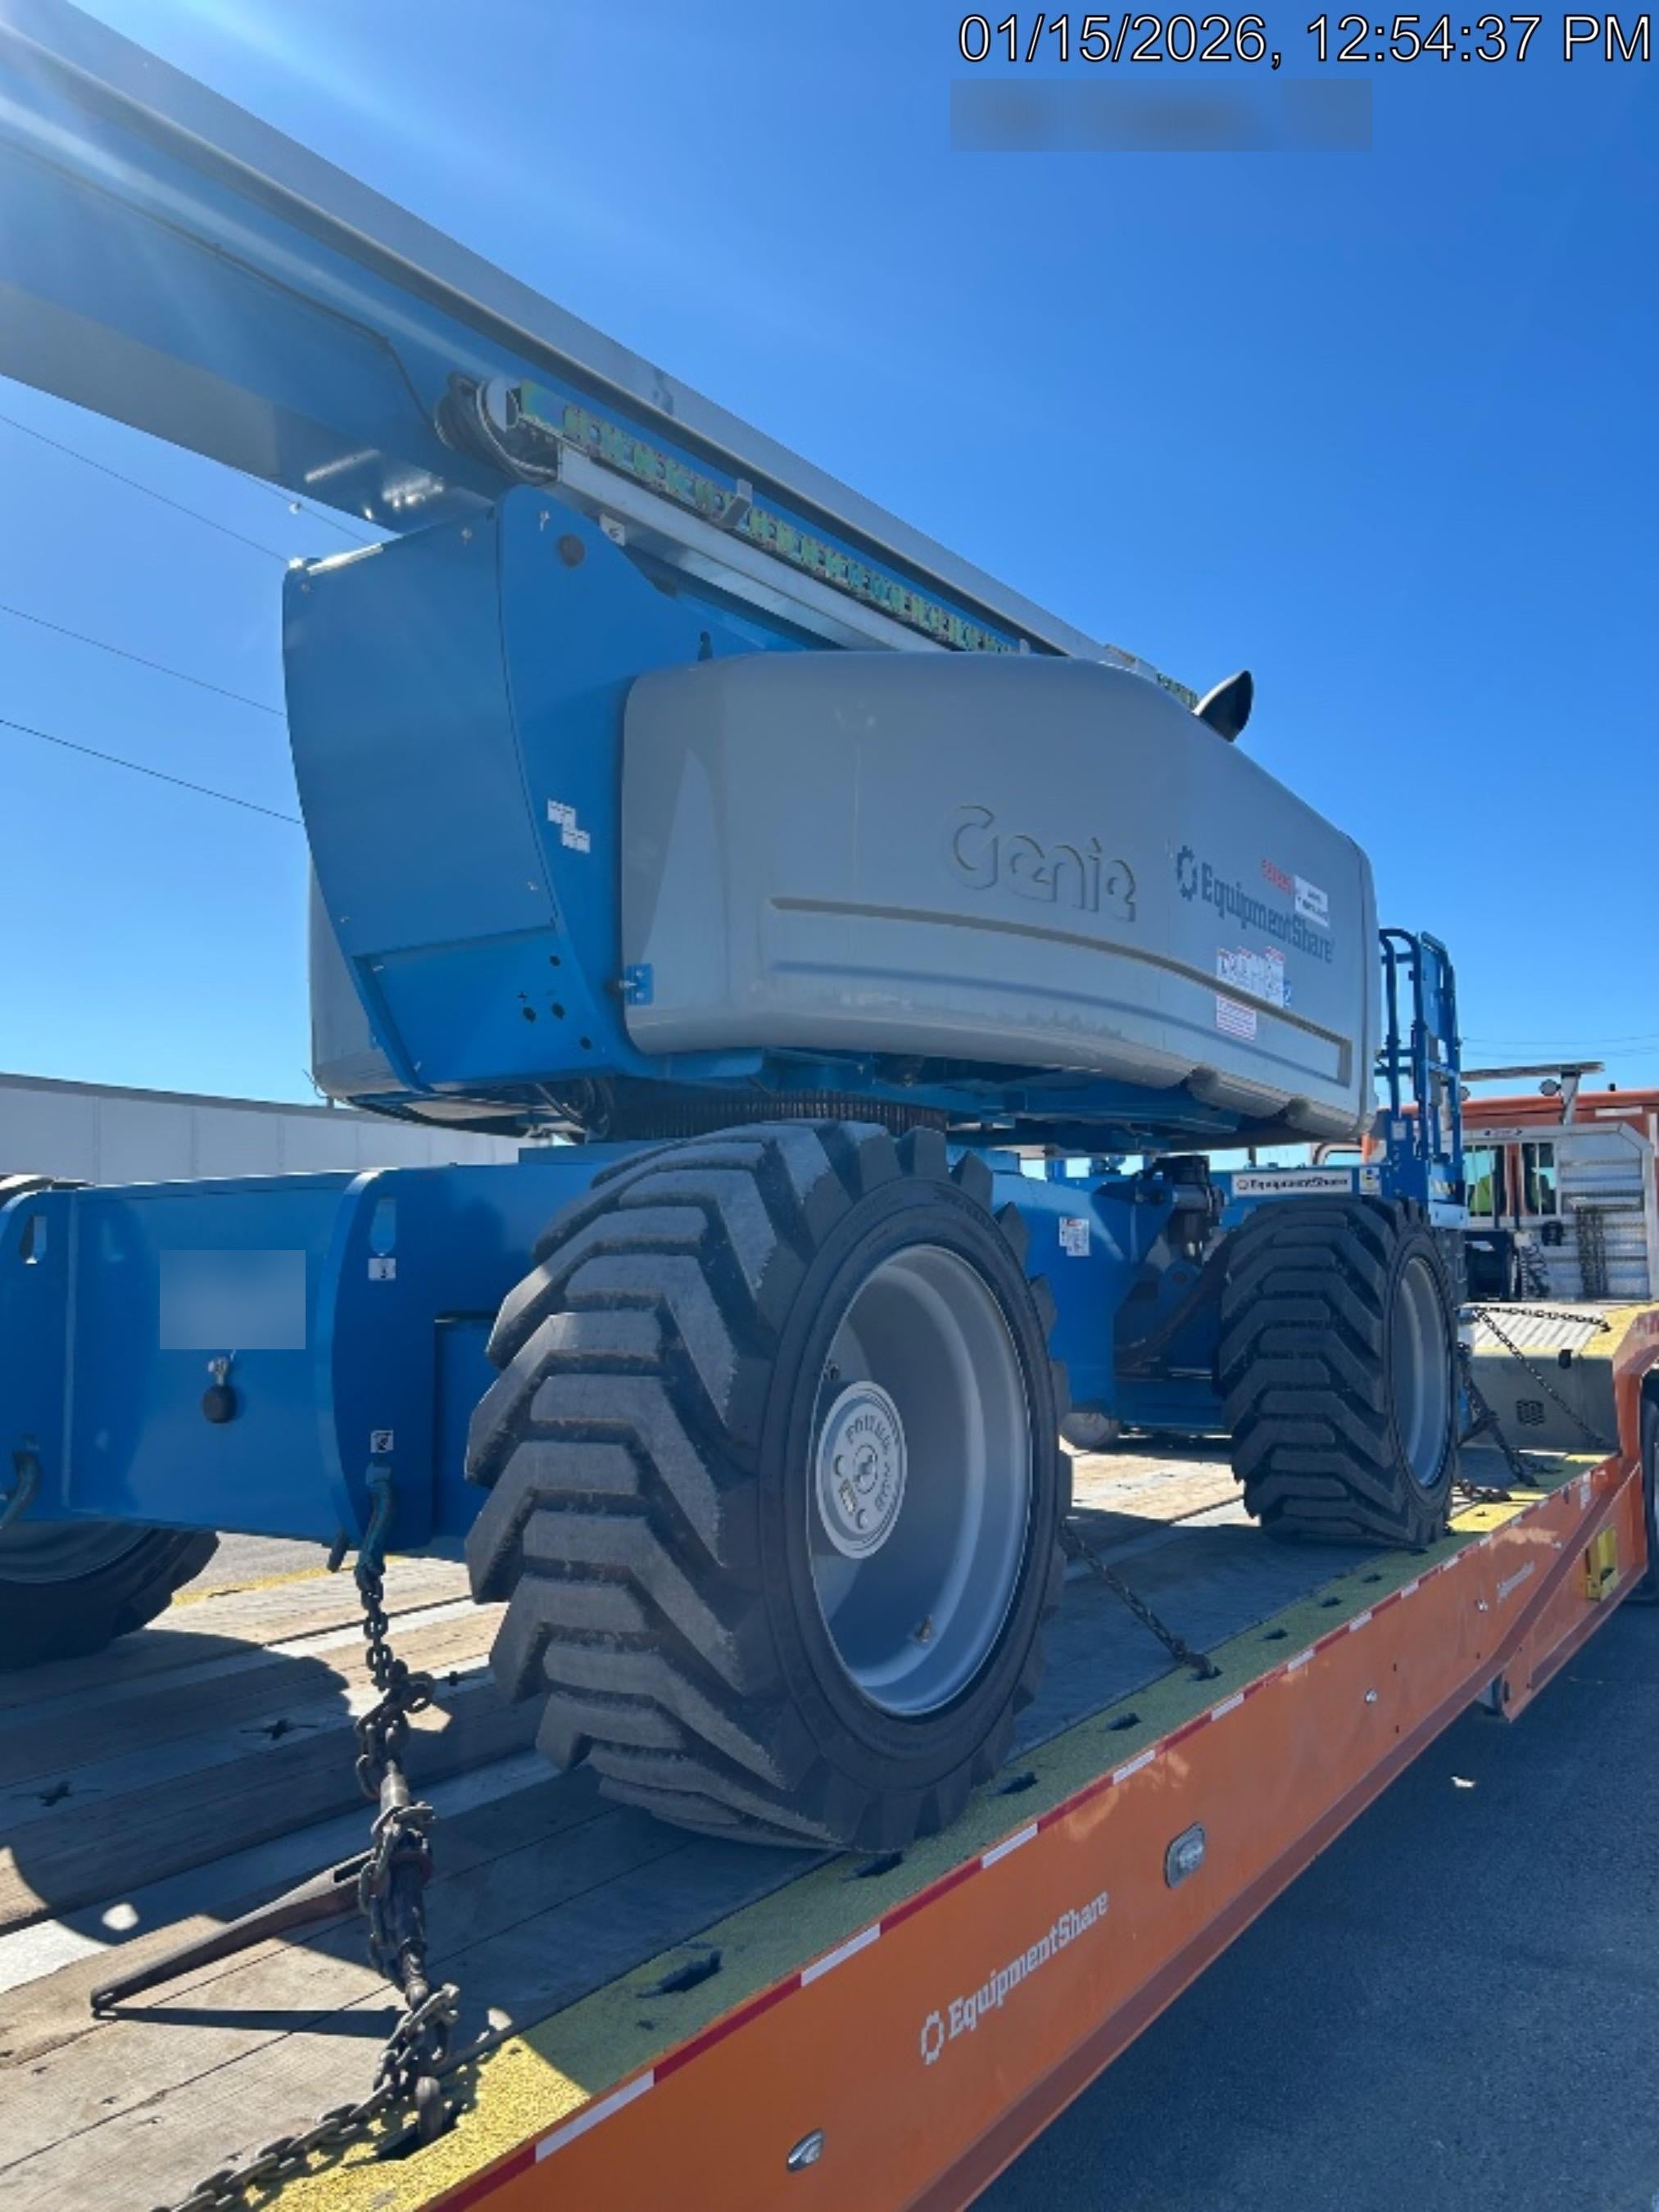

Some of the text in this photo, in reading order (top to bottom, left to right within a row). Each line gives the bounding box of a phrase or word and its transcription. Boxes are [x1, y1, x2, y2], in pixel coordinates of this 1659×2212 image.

[946, 804, 1137, 923] Genie
[1201, 862, 1333, 964] EquipmentShare
[948, 1891, 1109, 2041] EquipmentShare
